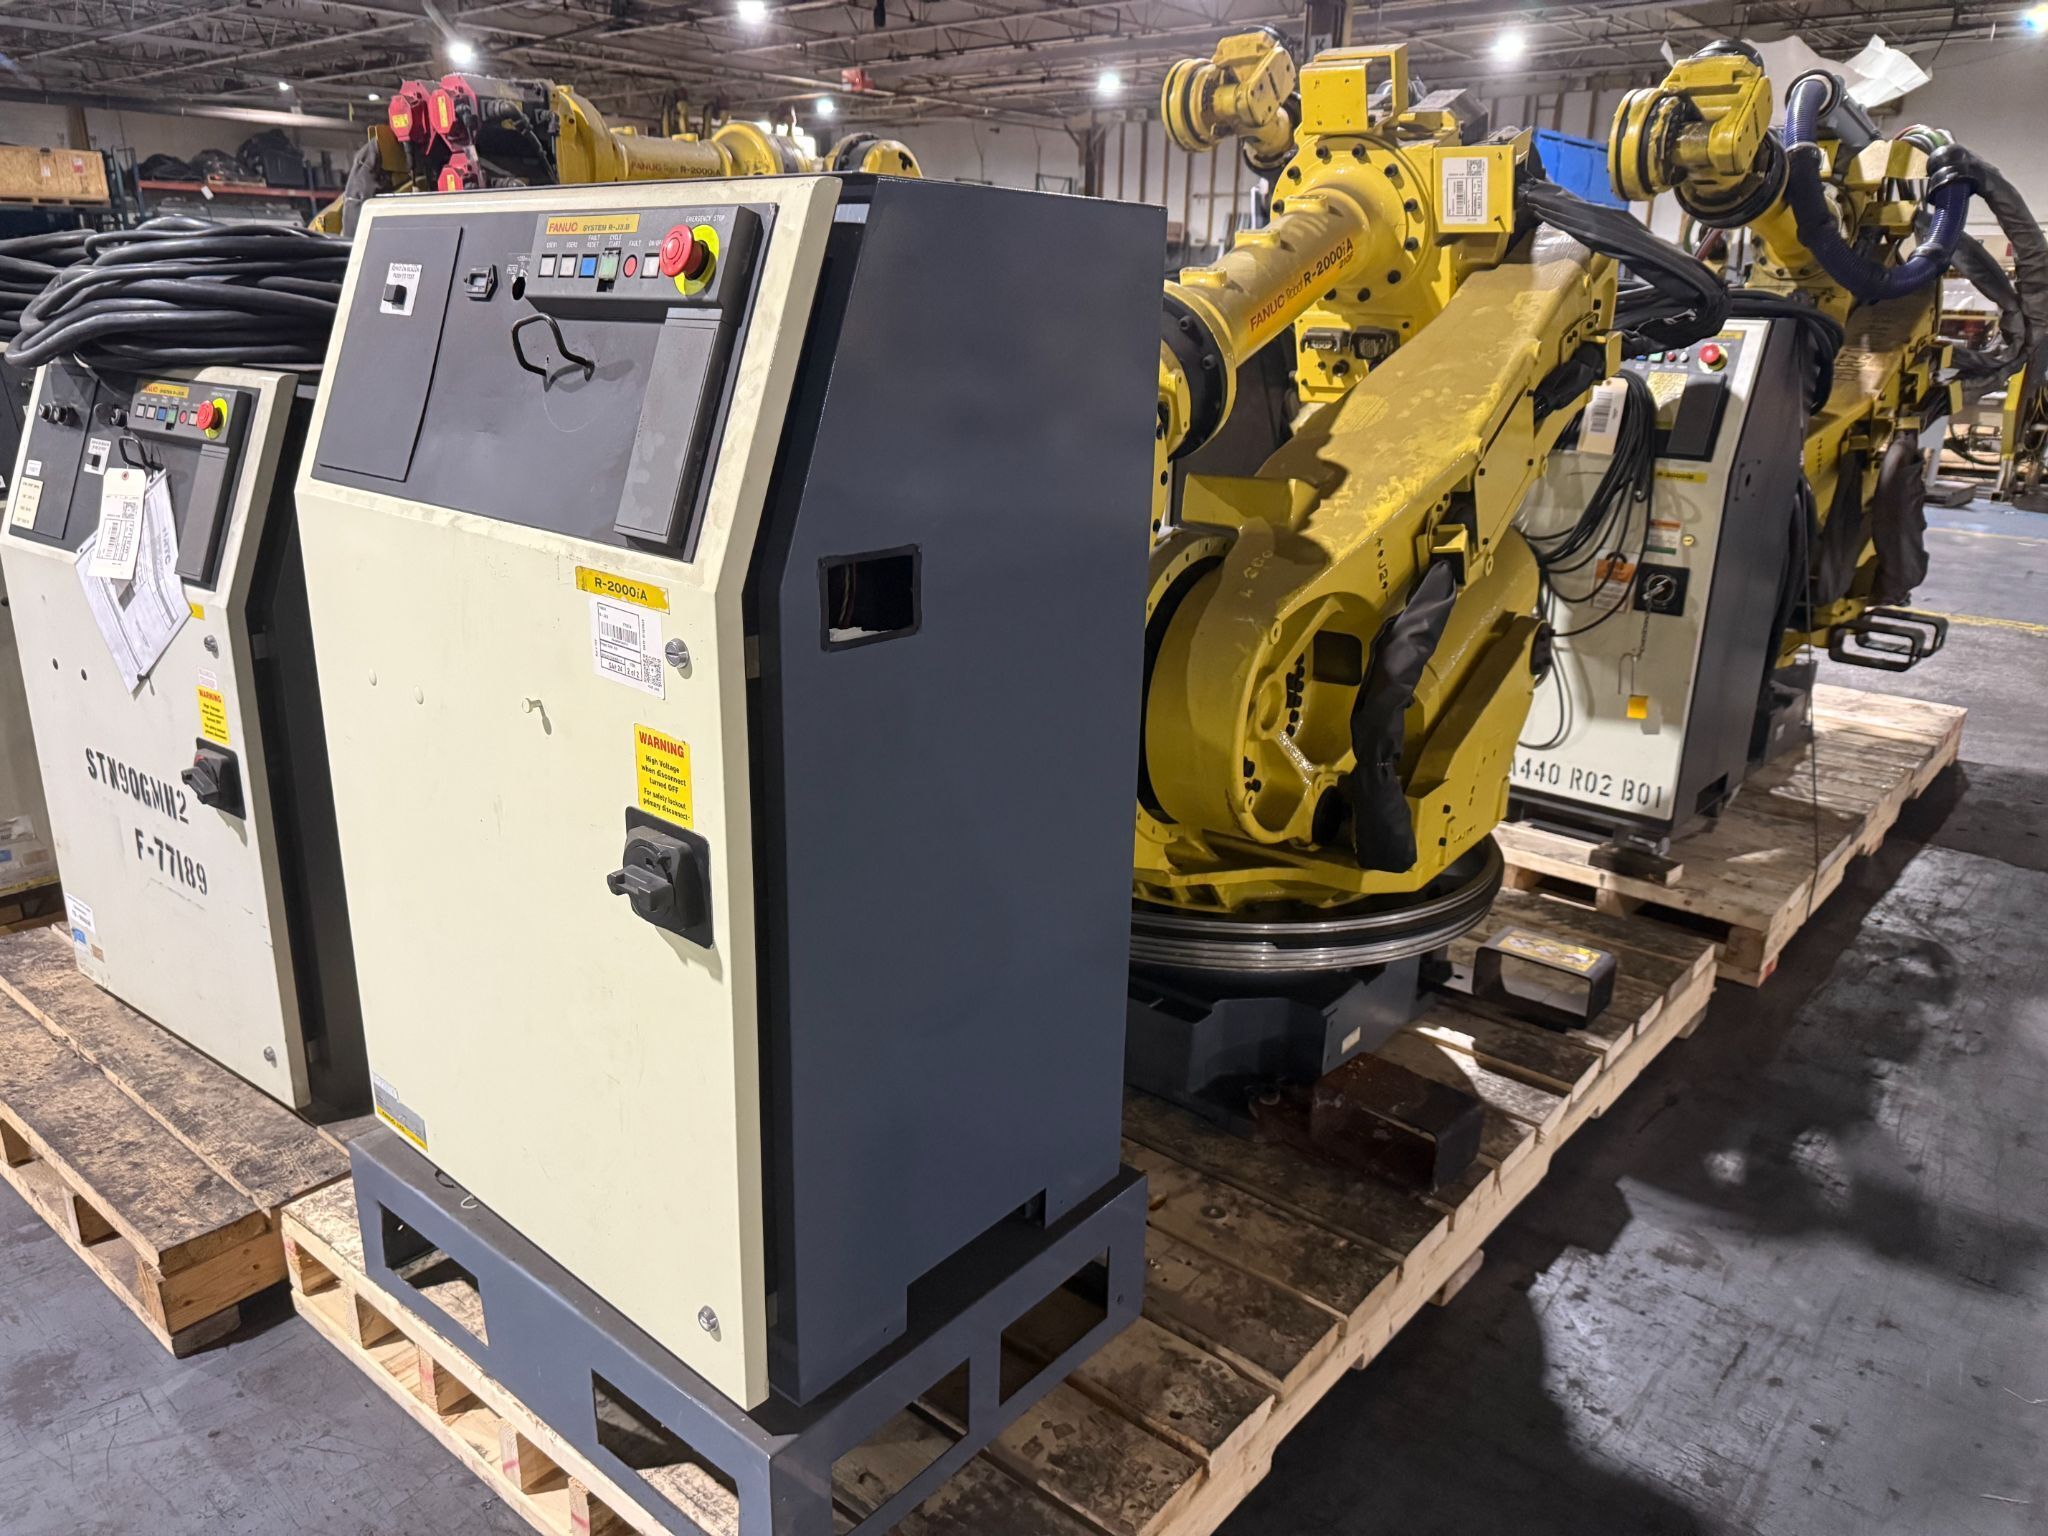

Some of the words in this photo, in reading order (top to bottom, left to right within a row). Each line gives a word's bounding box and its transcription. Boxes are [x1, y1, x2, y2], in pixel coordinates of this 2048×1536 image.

[630, 160, 662, 172] FANUC
[548, 222, 578, 233] FANUC
[582, 224, 607, 232] SYSTEM
[685, 215, 711, 223] EMERGENCY
[713, 214, 726, 222] STOP
[1249, 294, 1285, 331] FANUC
[1303, 237, 1354, 287] R-2000iA
[594, 577, 648, 601] R-2000iA
[639, 730, 685, 758] WARNING
[645, 755, 658, 765] High
[659, 760, 680, 774] Voltage
[641, 764, 656, 775] when
[657, 770, 687, 787] disconnect
[649, 777, 667, 789] turned
[668, 784, 679, 794] OFF
[1569, 767, 1613, 797] R02
[1621, 778, 1663, 809] B01
[643, 787, 652, 796] For
[652, 790, 667, 804] safety
[643, 798, 661, 811] primary
[135, 827, 208, 896] F-77189
